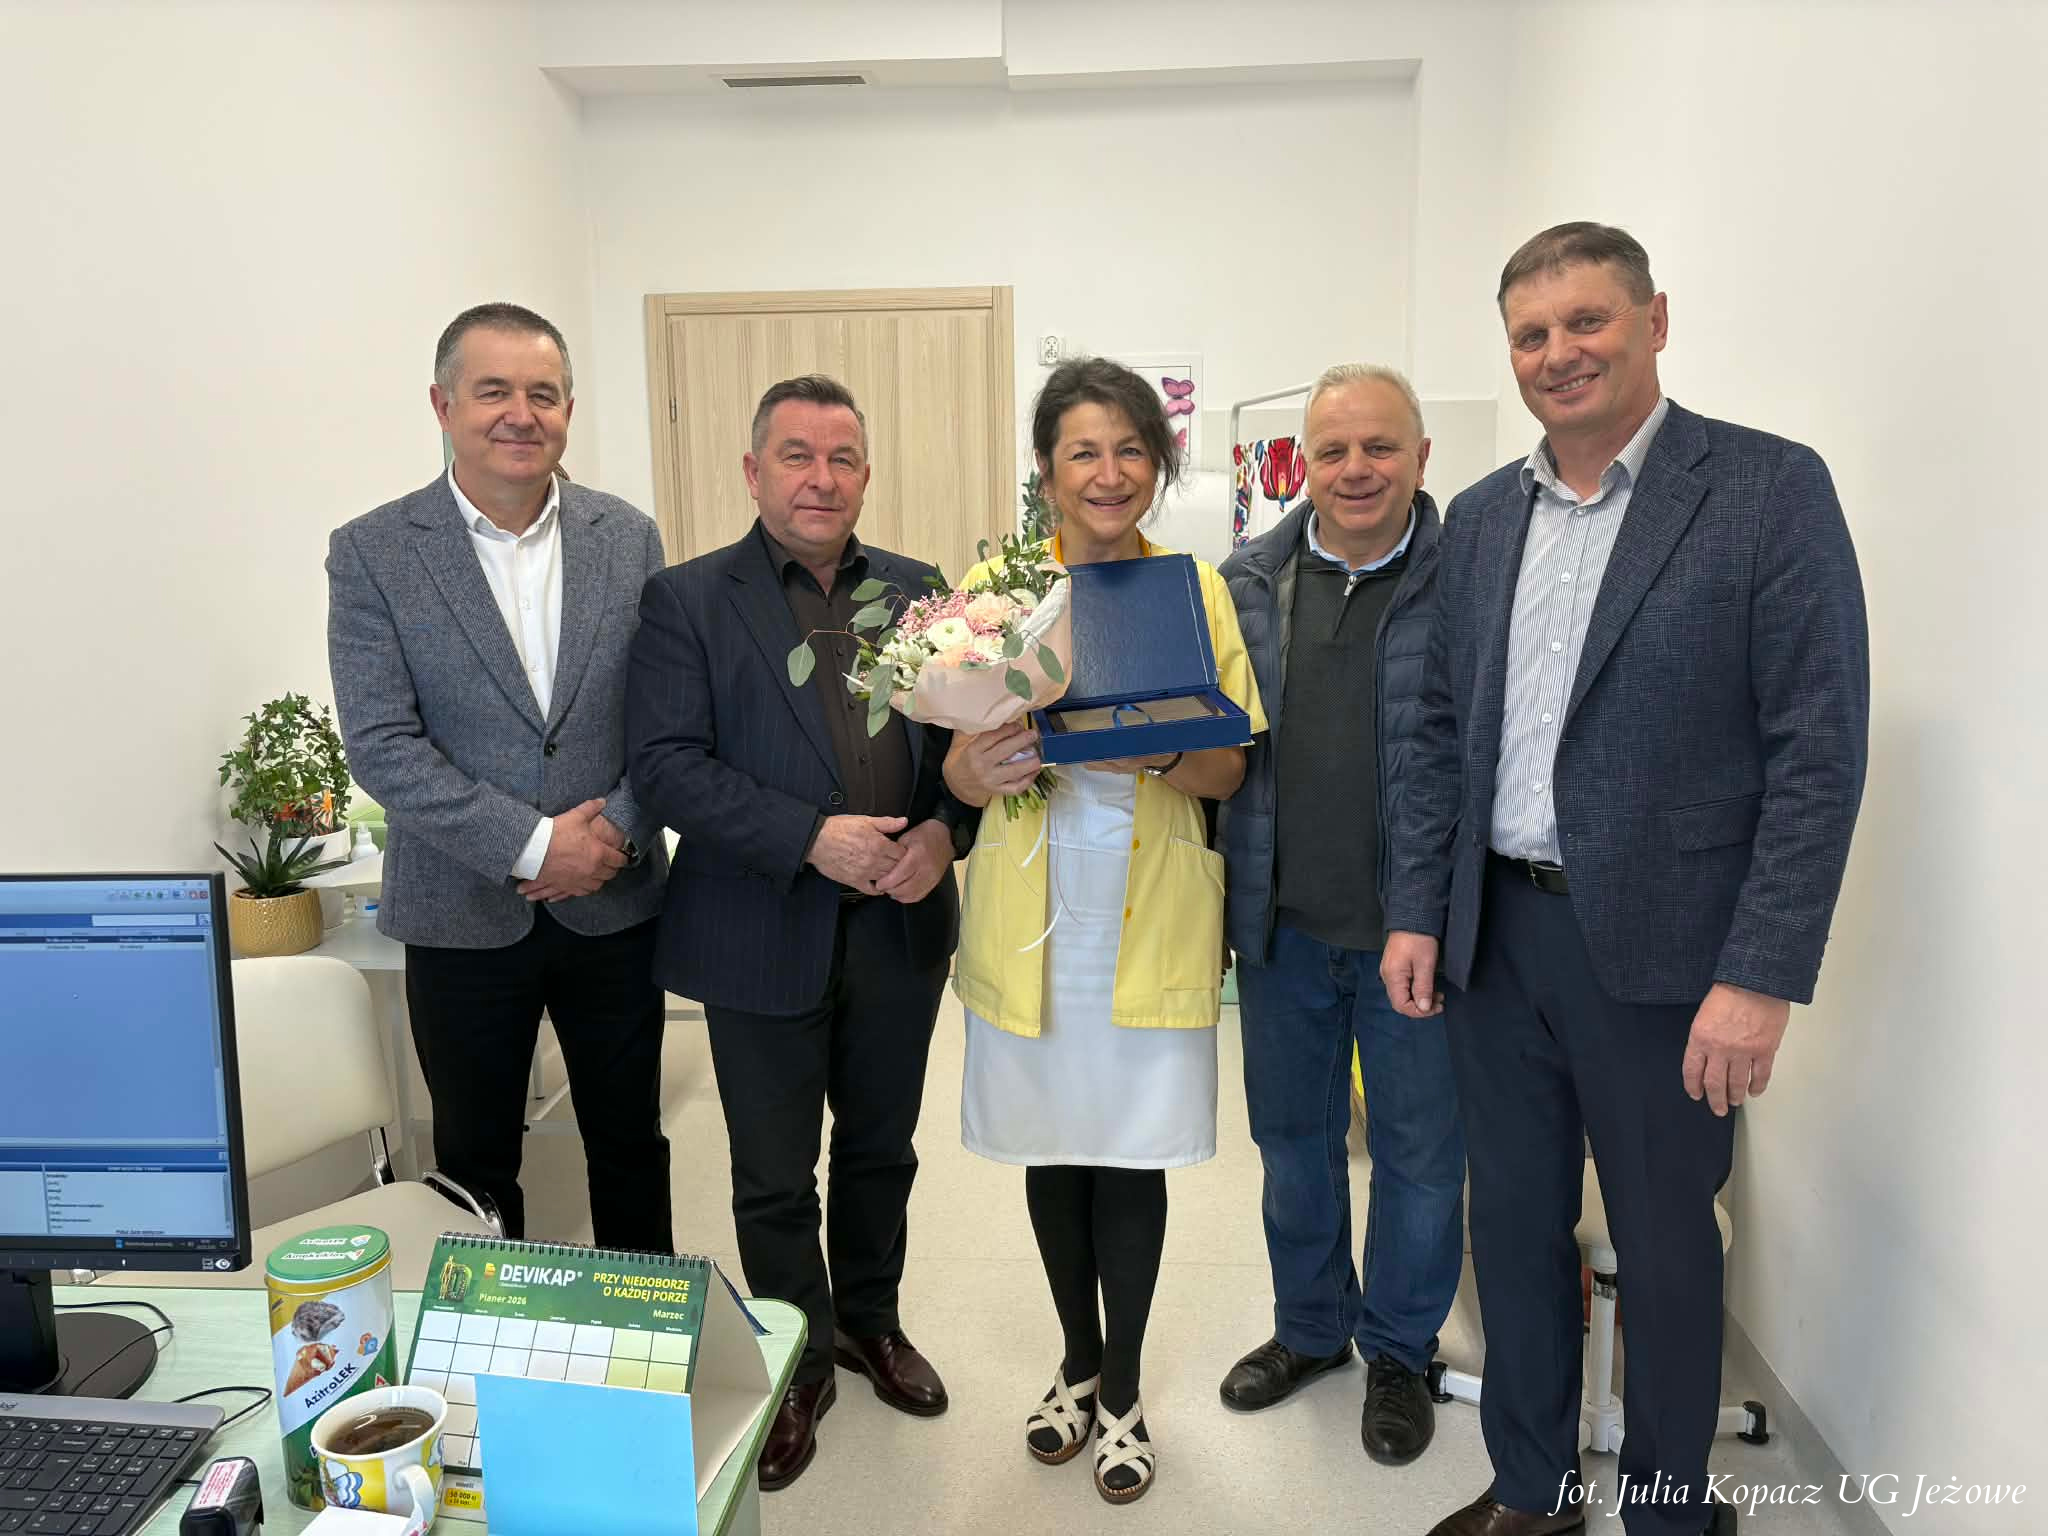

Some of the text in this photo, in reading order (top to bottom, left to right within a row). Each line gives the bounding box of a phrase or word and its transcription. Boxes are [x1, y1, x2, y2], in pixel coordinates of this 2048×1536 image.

[593, 1272, 690, 1291] PRZY NIEDOBORZE
[479, 1293, 527, 1305] Planer 2026
[603, 1286, 688, 1304] O KAŻDEJ PORZE
[652, 1308, 685, 1320] Marzec
[304, 1362, 357, 1409] AzitroLEK
